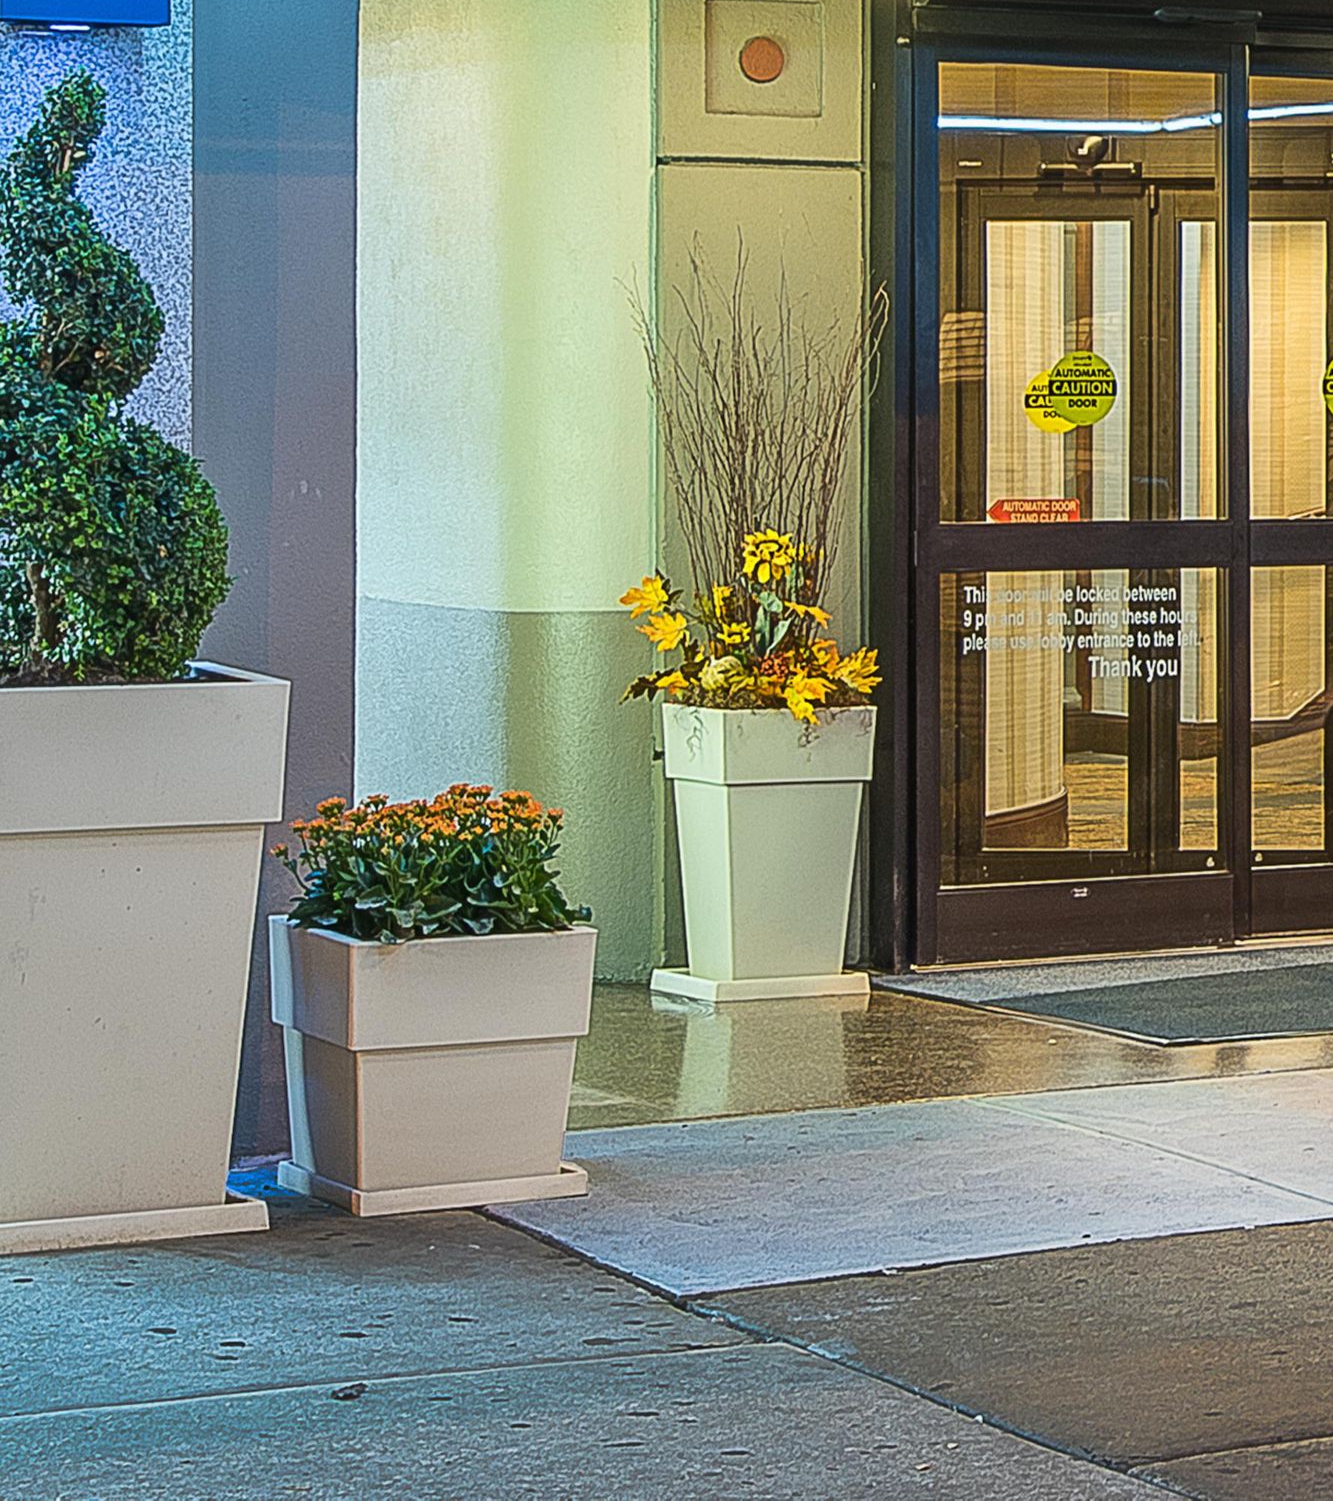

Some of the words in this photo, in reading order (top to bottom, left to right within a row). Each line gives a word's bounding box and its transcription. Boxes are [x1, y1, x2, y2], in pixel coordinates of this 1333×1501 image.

[1055, 368, 1112, 378] AUTOMATIC
[1051, 381, 1113, 395] CAUTION
[1068, 398, 1097, 408] DOOR
[1002, 501, 1050, 512] AUTOMATIC
[1051, 500, 1076, 512] DOOR
[1010, 512, 1038, 523] STAND
[1040, 512, 1069, 523] CLEAR
[1076, 585, 1120, 602] locked
[1123, 584, 1177, 602] between
[963, 609, 972, 627] 9
[1074, 607, 1118, 629] During
[1121, 607, 1157, 624] these
[1077, 631, 1134, 649] entrance
[1137, 630, 1151, 647] to
[1153, 630, 1174, 647] the
[1088, 654, 1143, 678] Thank
[1146, 659, 1178, 682] you
